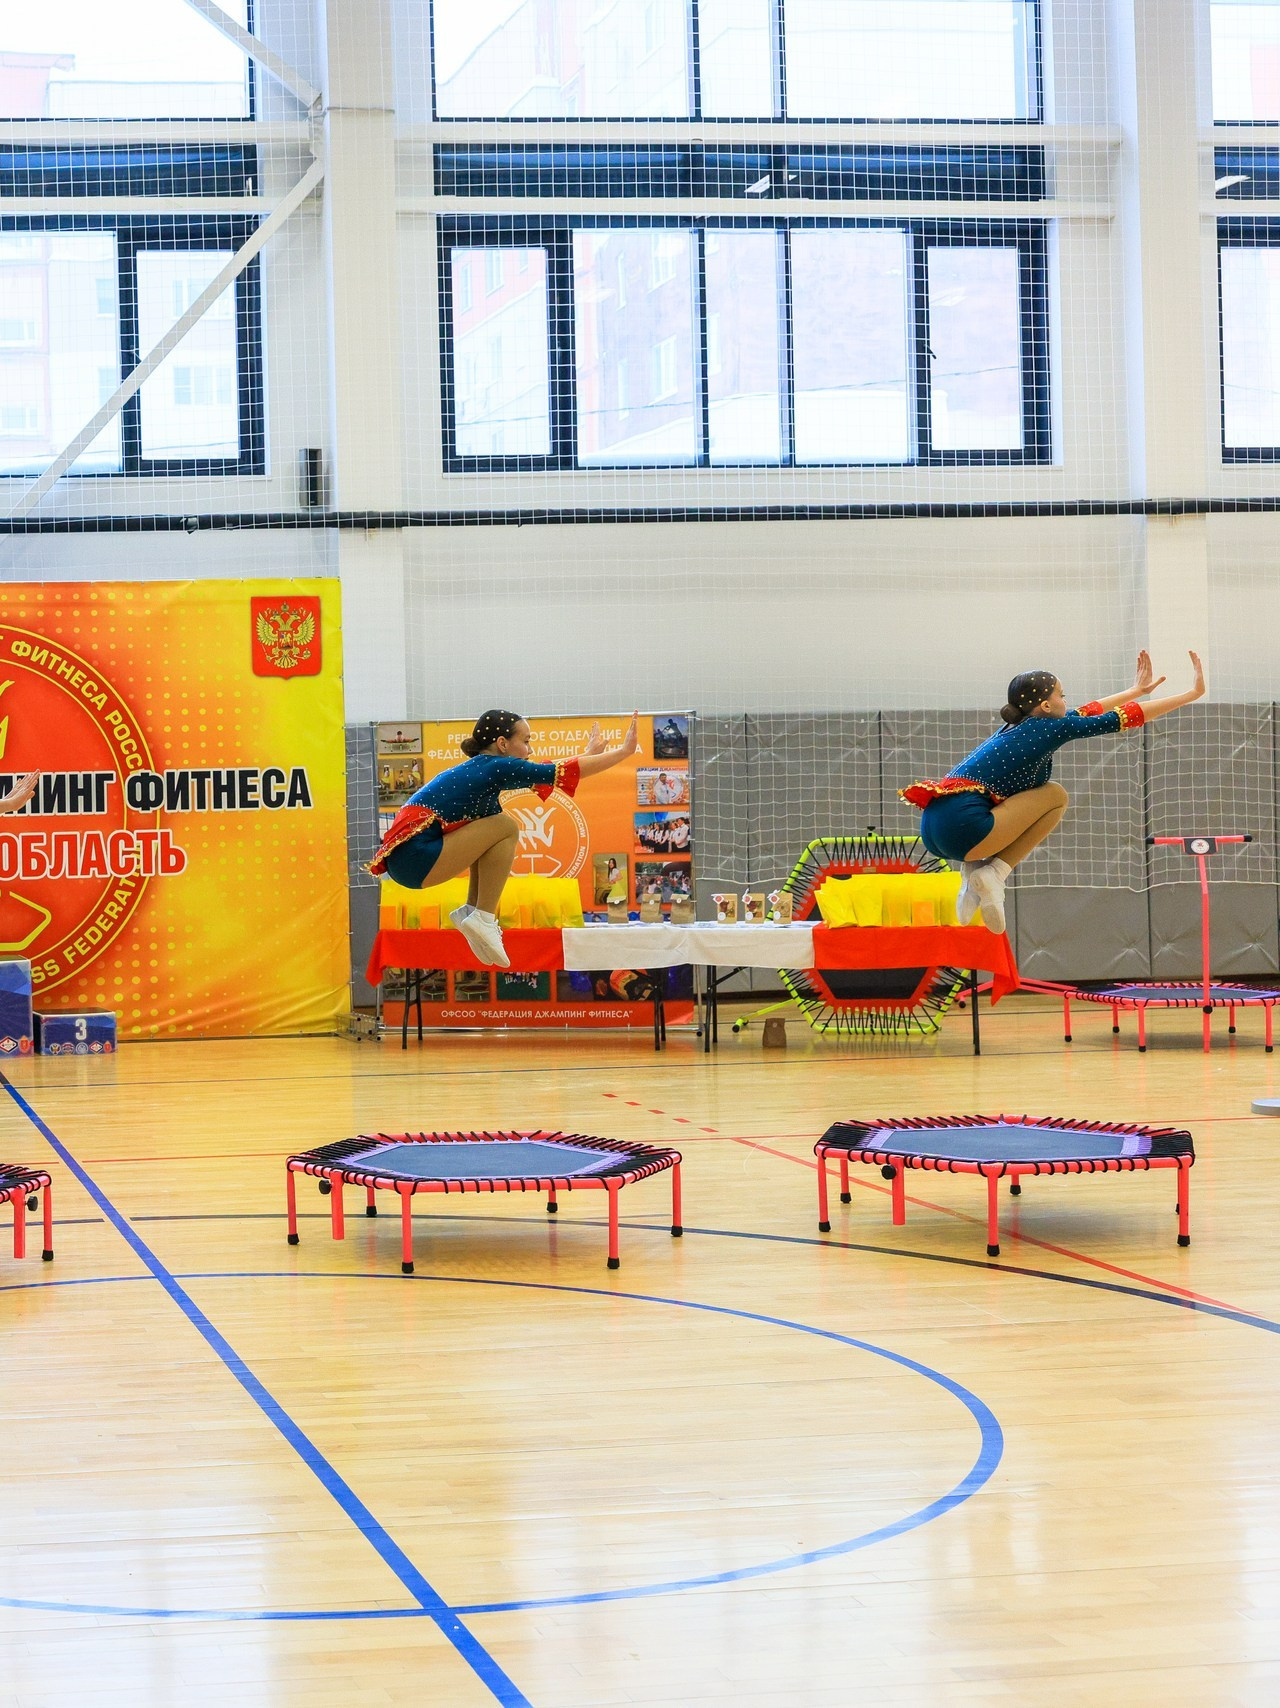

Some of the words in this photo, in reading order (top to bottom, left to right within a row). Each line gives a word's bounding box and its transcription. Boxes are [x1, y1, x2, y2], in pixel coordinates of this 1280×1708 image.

[11, 640, 109, 711] ФИТНЕСА
[104, 709, 145, 774] РОСС
[126, 767, 313, 813] ФИТНЕСА
[75, 1018, 87, 1040] 3
[441, 1010, 476, 1018] ОФСОО
[478, 1009, 533, 1019] "ФЕДЕРАЦИЯ
[535, 1010, 587, 1019] ДЖАМПИНГ
[588, 1009, 634, 1018] ФИТНЕСА"
